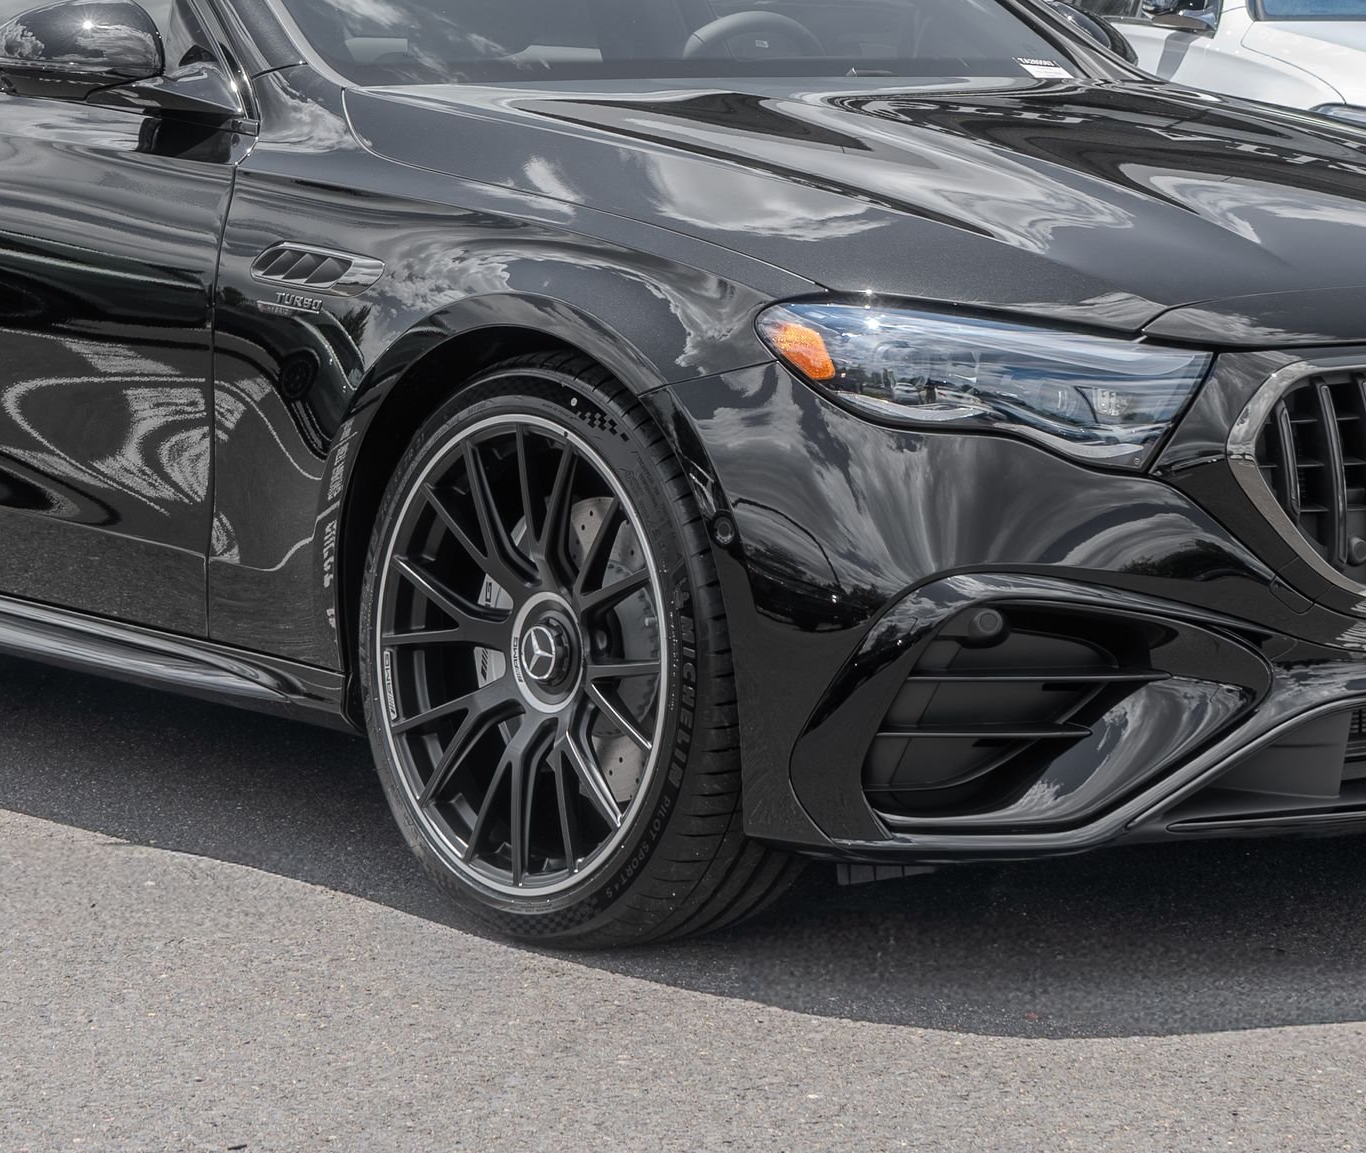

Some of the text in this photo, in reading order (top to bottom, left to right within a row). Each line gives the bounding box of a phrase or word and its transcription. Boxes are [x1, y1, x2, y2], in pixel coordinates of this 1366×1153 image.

[275, 292, 323, 311] TURBO
[668, 615, 697, 789] MICHELIN
[649, 794, 671, 840] PILOT
[619, 840, 651, 885] SPORT
